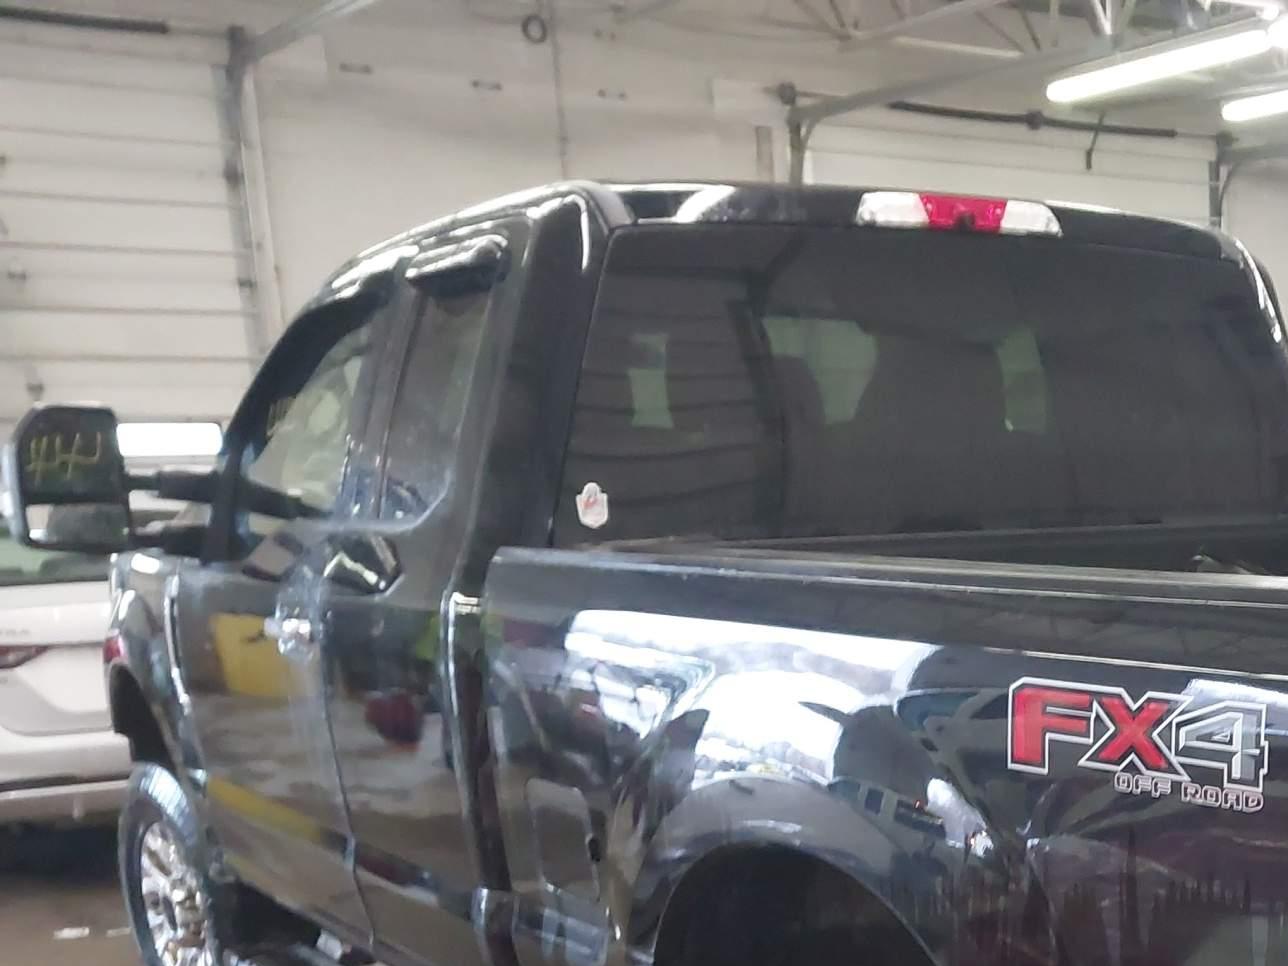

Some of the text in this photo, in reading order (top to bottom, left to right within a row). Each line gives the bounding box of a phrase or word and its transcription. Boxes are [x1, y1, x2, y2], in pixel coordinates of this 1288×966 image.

[1007, 676, 1269, 792] FX4
[1114, 771, 1264, 813] OFF ROAD
